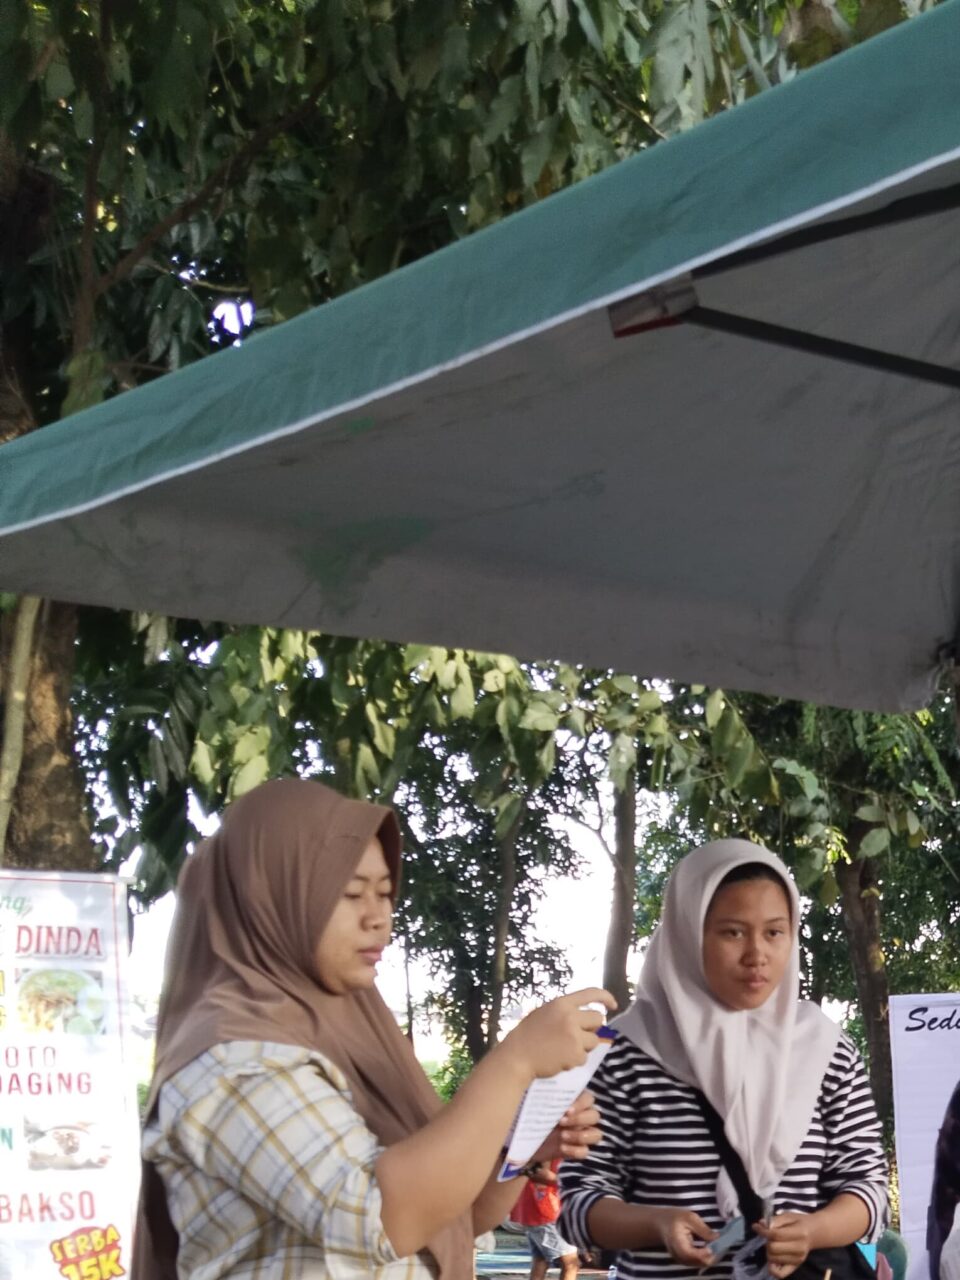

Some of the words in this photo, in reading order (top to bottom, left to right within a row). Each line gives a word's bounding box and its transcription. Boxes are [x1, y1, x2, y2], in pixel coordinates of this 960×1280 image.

[15, 925, 102, 957] DINDA
[0, 1072, 92, 1096] AGING
[0, 1190, 95, 1223] BAKSO
[50, 1223, 122, 1264] SERBA
